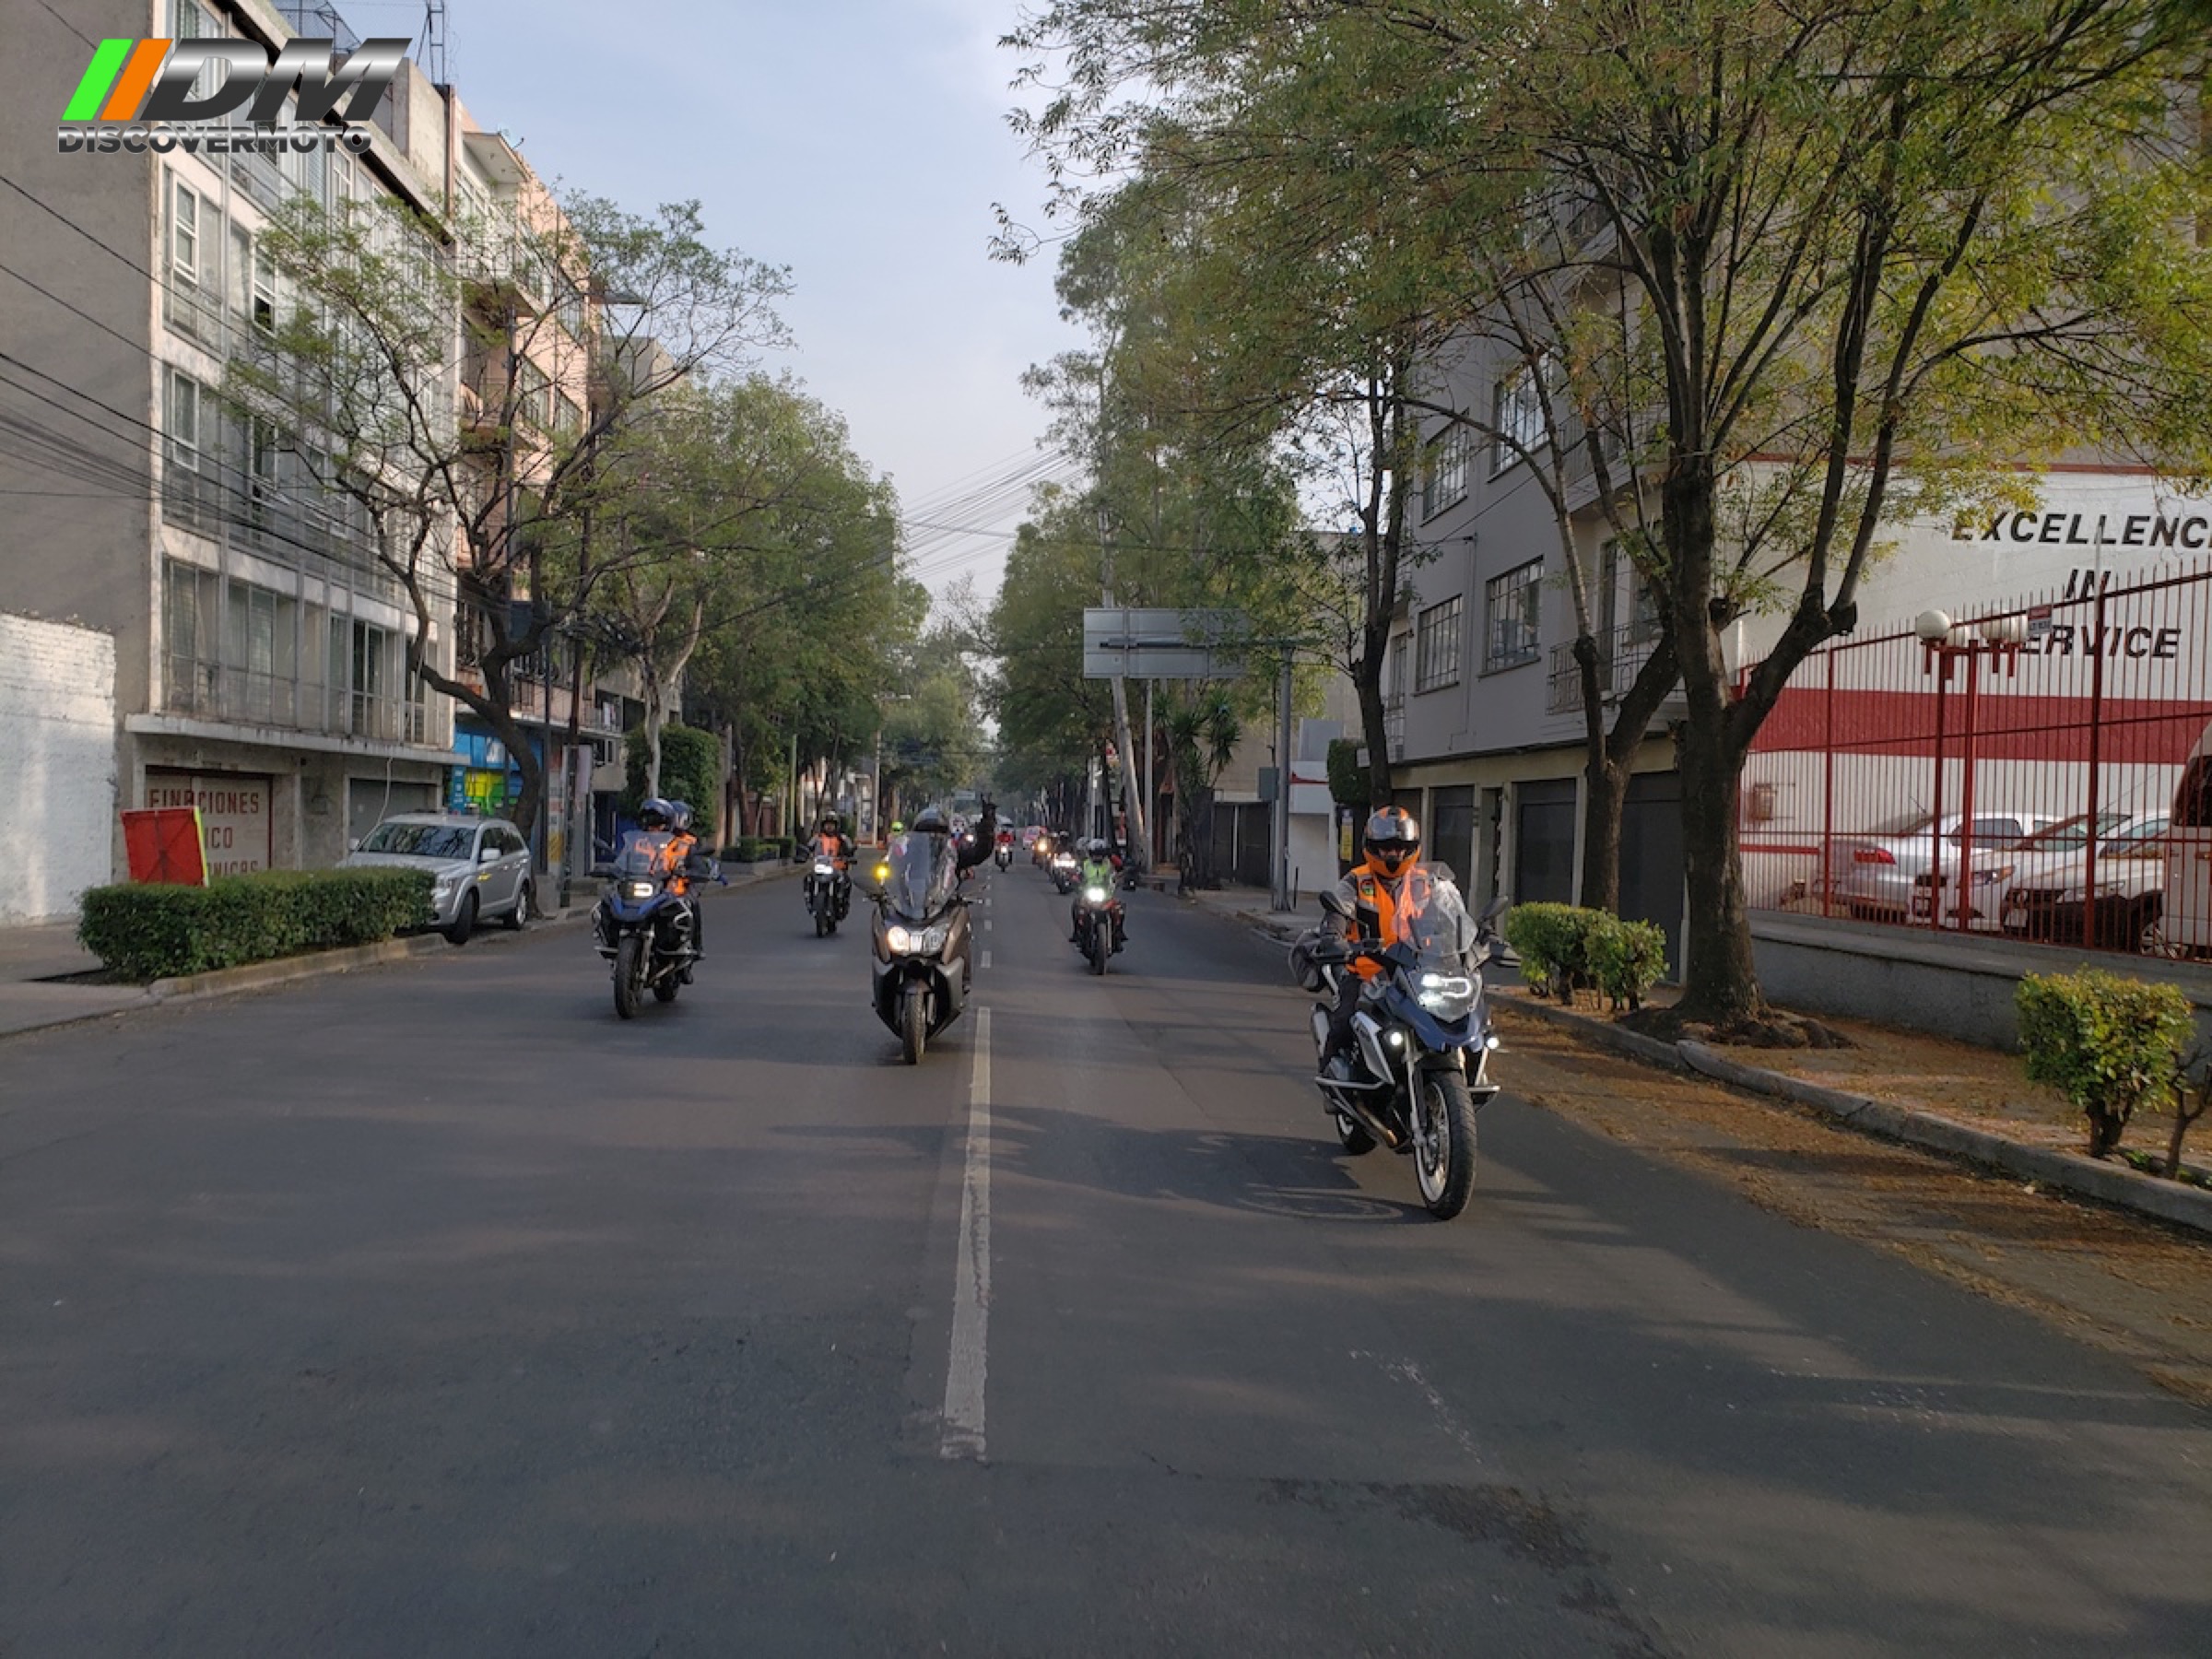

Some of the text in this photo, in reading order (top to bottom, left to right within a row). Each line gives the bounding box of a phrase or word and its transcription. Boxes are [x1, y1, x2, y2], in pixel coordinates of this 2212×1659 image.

[1951, 512, 2212, 548] EXCELLENC
[2065, 569, 2111, 600] IN
[2019, 625, 2182, 658] ERVICE
[205, 827, 233, 849] ICO
